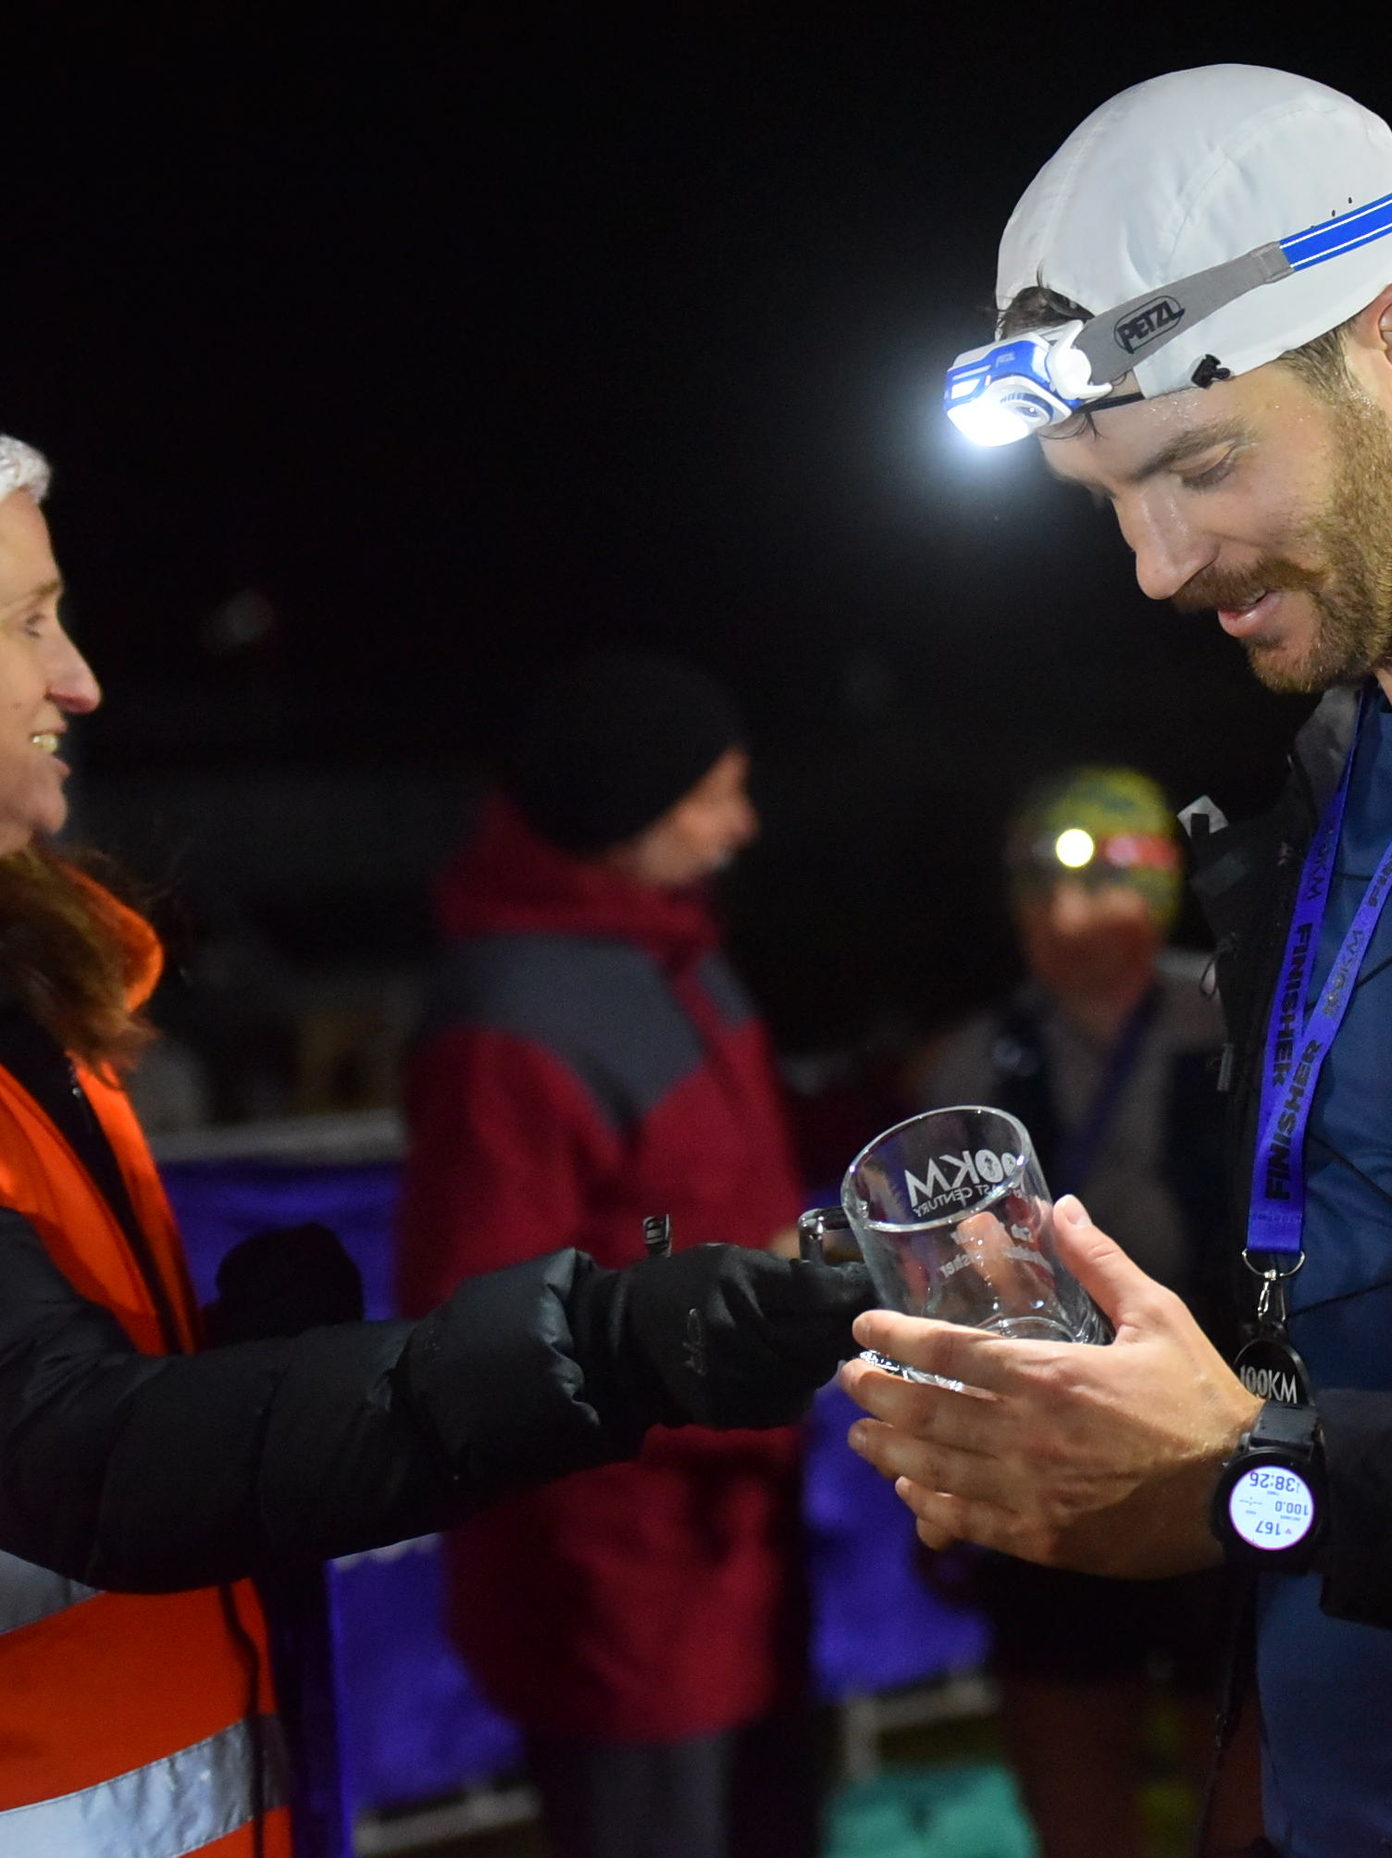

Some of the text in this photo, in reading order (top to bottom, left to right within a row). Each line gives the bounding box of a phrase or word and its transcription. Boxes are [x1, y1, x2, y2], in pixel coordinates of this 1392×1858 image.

[1116, 300, 1186, 354] PETZL
[1273, 922, 1314, 1087] FINISHER
[1266, 1039, 1323, 1201] FINISHER
[1240, 1363, 1297, 1404] 100KM
[1254, 1520, 1282, 1537] 167
[1274, 1500, 1309, 1516] 100.0
